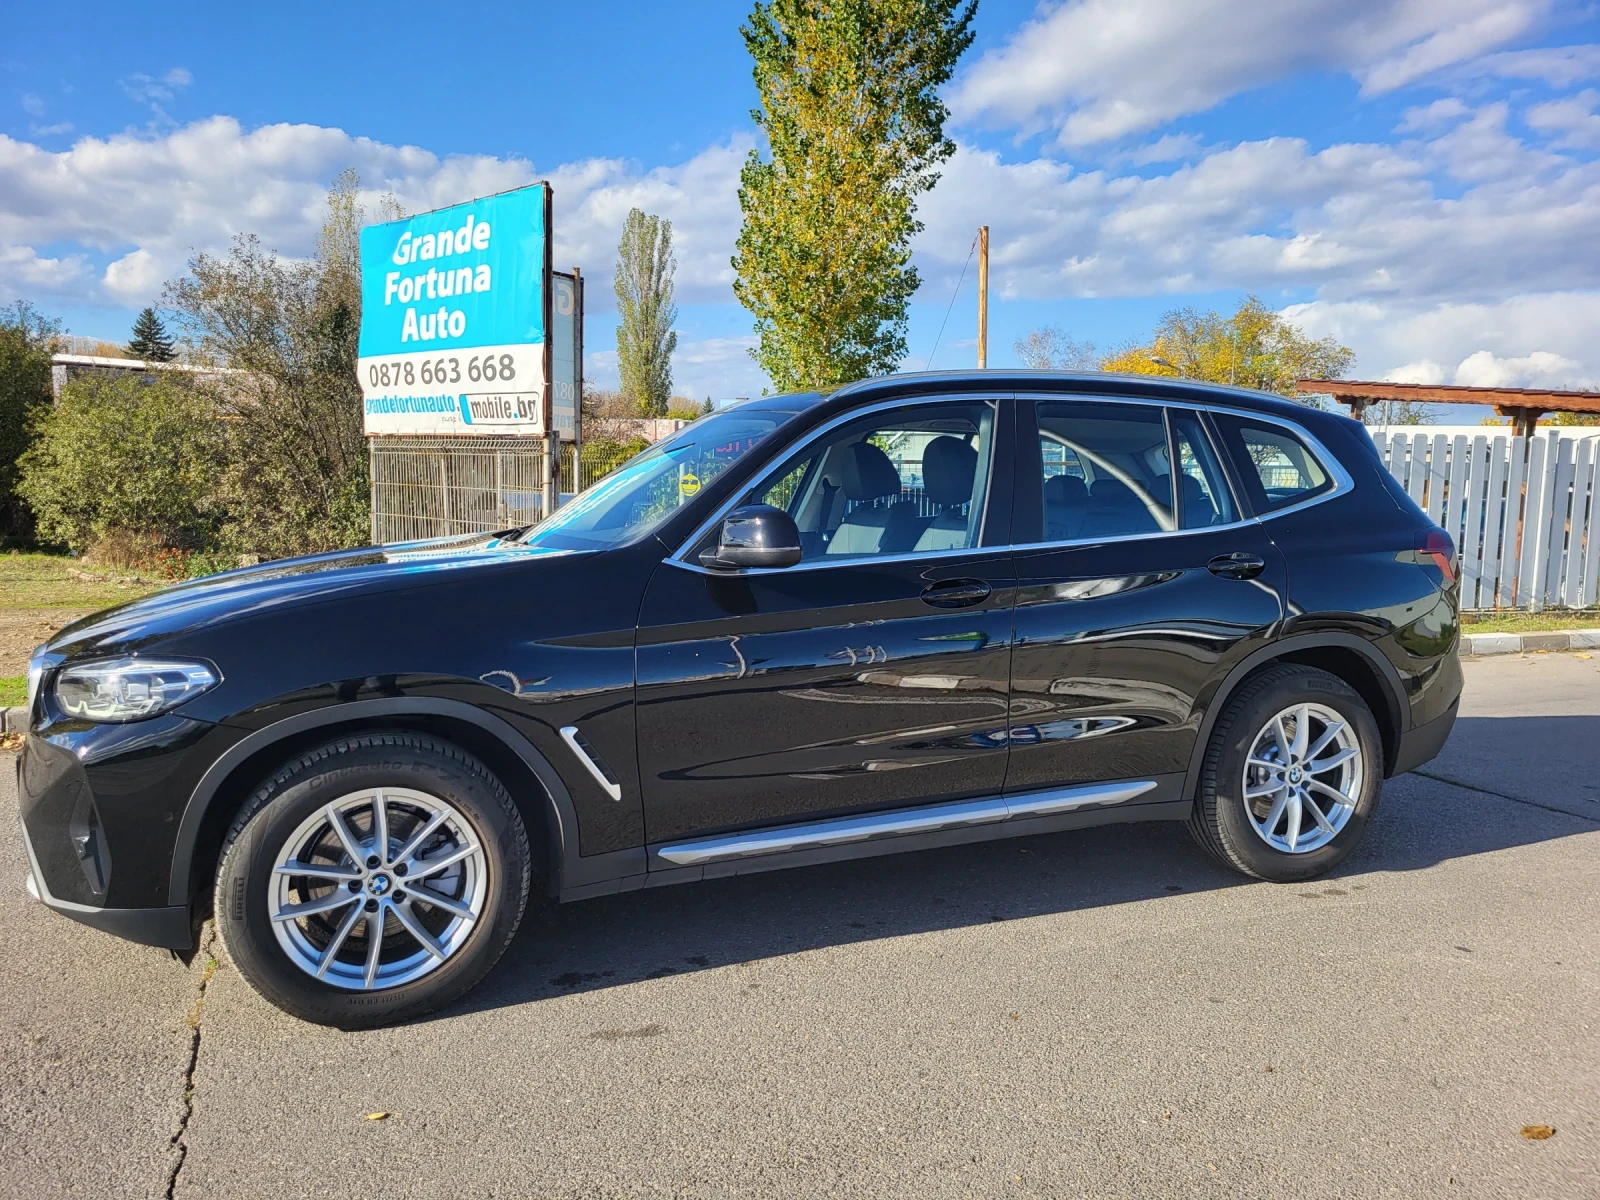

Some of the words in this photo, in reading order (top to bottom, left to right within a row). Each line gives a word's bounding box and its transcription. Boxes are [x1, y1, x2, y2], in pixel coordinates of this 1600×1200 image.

[392, 214, 491, 266] Grande
[384, 264, 491, 306] Fortuna
[401, 306, 466, 343] Auto
[369, 361, 415, 388] 0878
[420, 357, 461, 384] 663
[468, 354, 516, 382] 668
[470, 396, 536, 421] mobile.bg
[232, 876, 245, 921] PIRELLI
